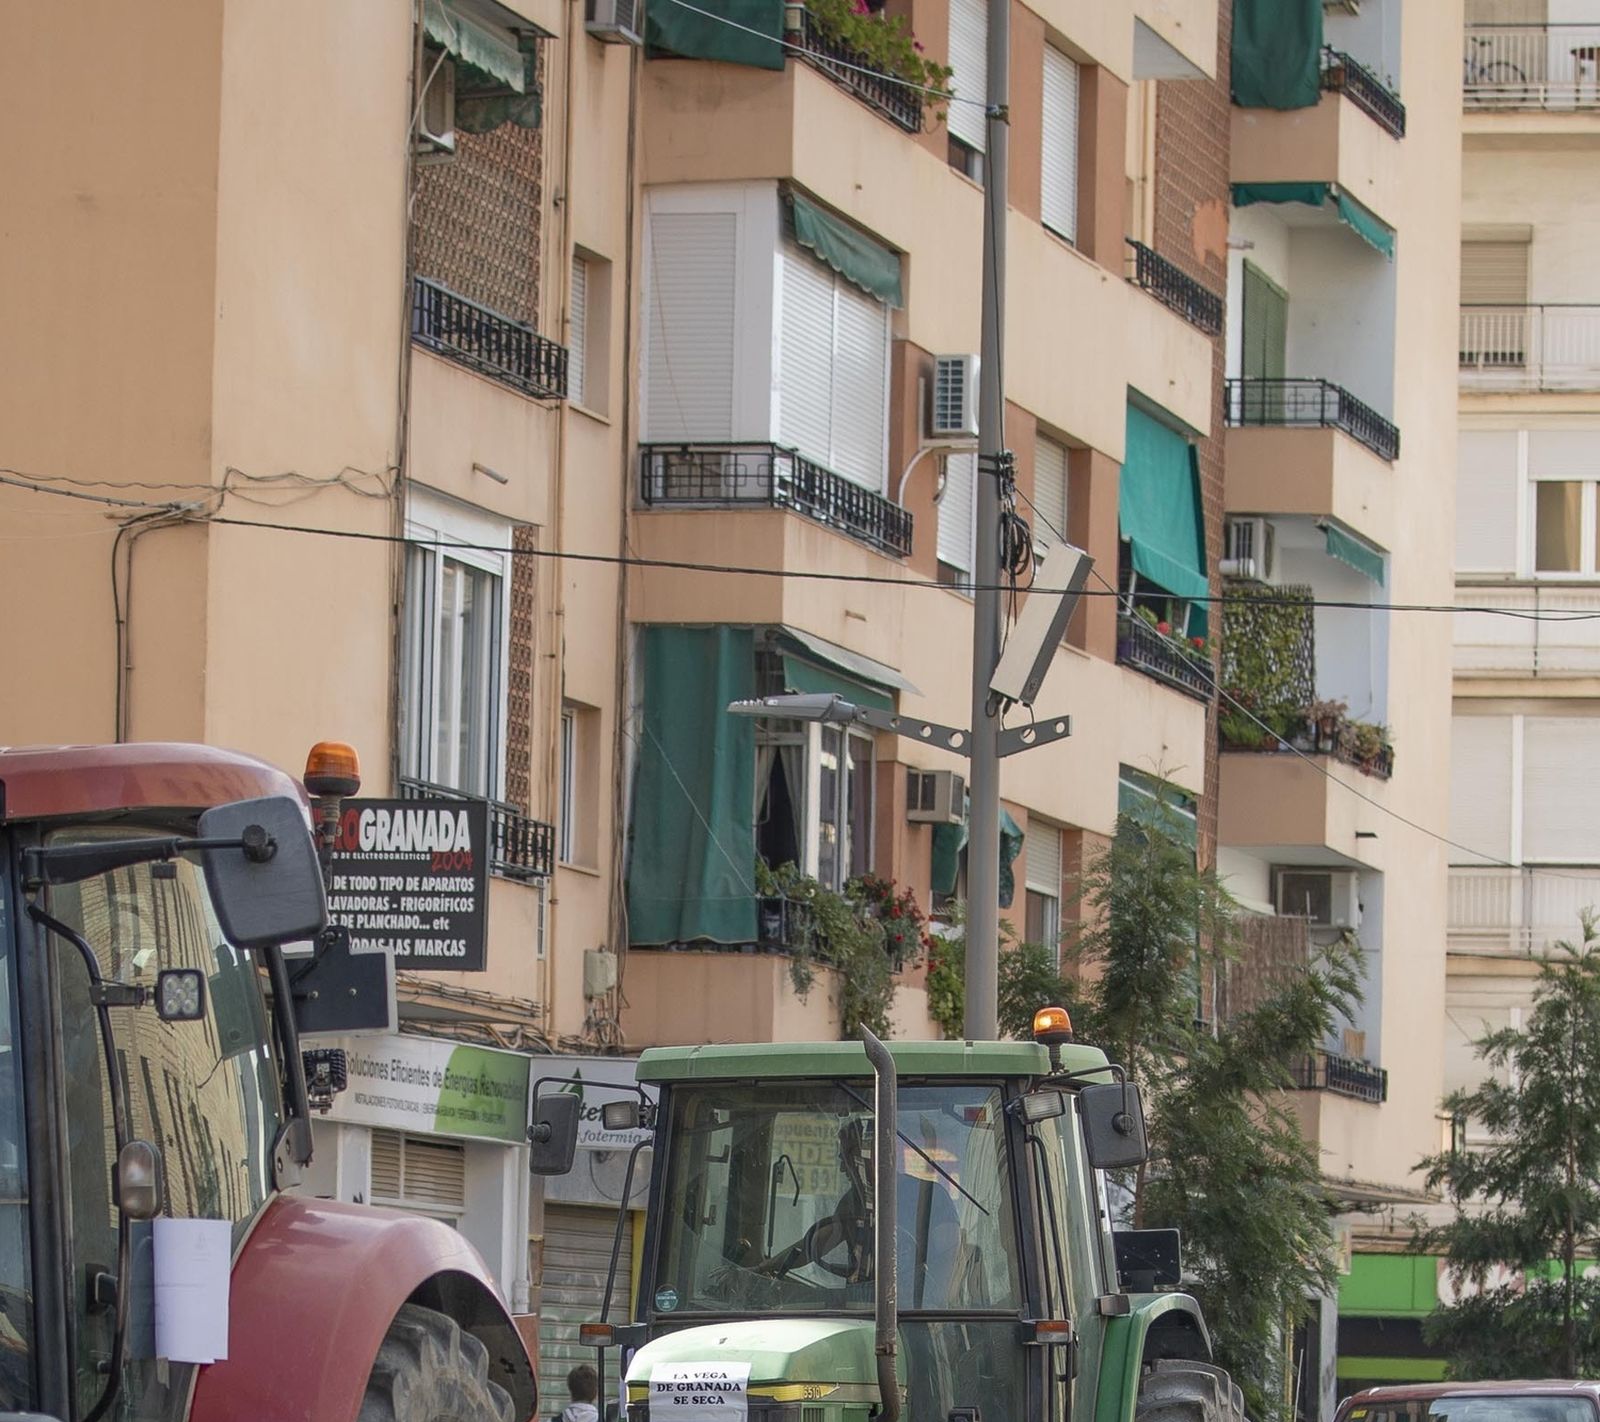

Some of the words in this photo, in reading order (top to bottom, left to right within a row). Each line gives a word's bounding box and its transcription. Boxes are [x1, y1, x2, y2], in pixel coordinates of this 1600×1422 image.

[432, 851, 473, 872] 2004
[333, 875, 347, 891] DE
[349, 875, 377, 891] TODO
[379, 876, 404, 891] TIPO
[405, 876, 420, 891] DE
[421, 876, 475, 892] APARATOS
[327, 895, 390, 911] LAVADORAS
[400, 893, 475, 912] FRIGORÍFICOS
[340, 914, 354, 928] DE
[433, 916, 450, 930] etc
[414, 938, 467, 956] MARCAS
[432, 1065, 443, 1089] de
[656, 1382, 674, 1392] DE
[676, 1382, 742, 1392] GRANADA
[673, 1395, 689, 1405] SE
[691, 1395, 726, 1405] SECA
